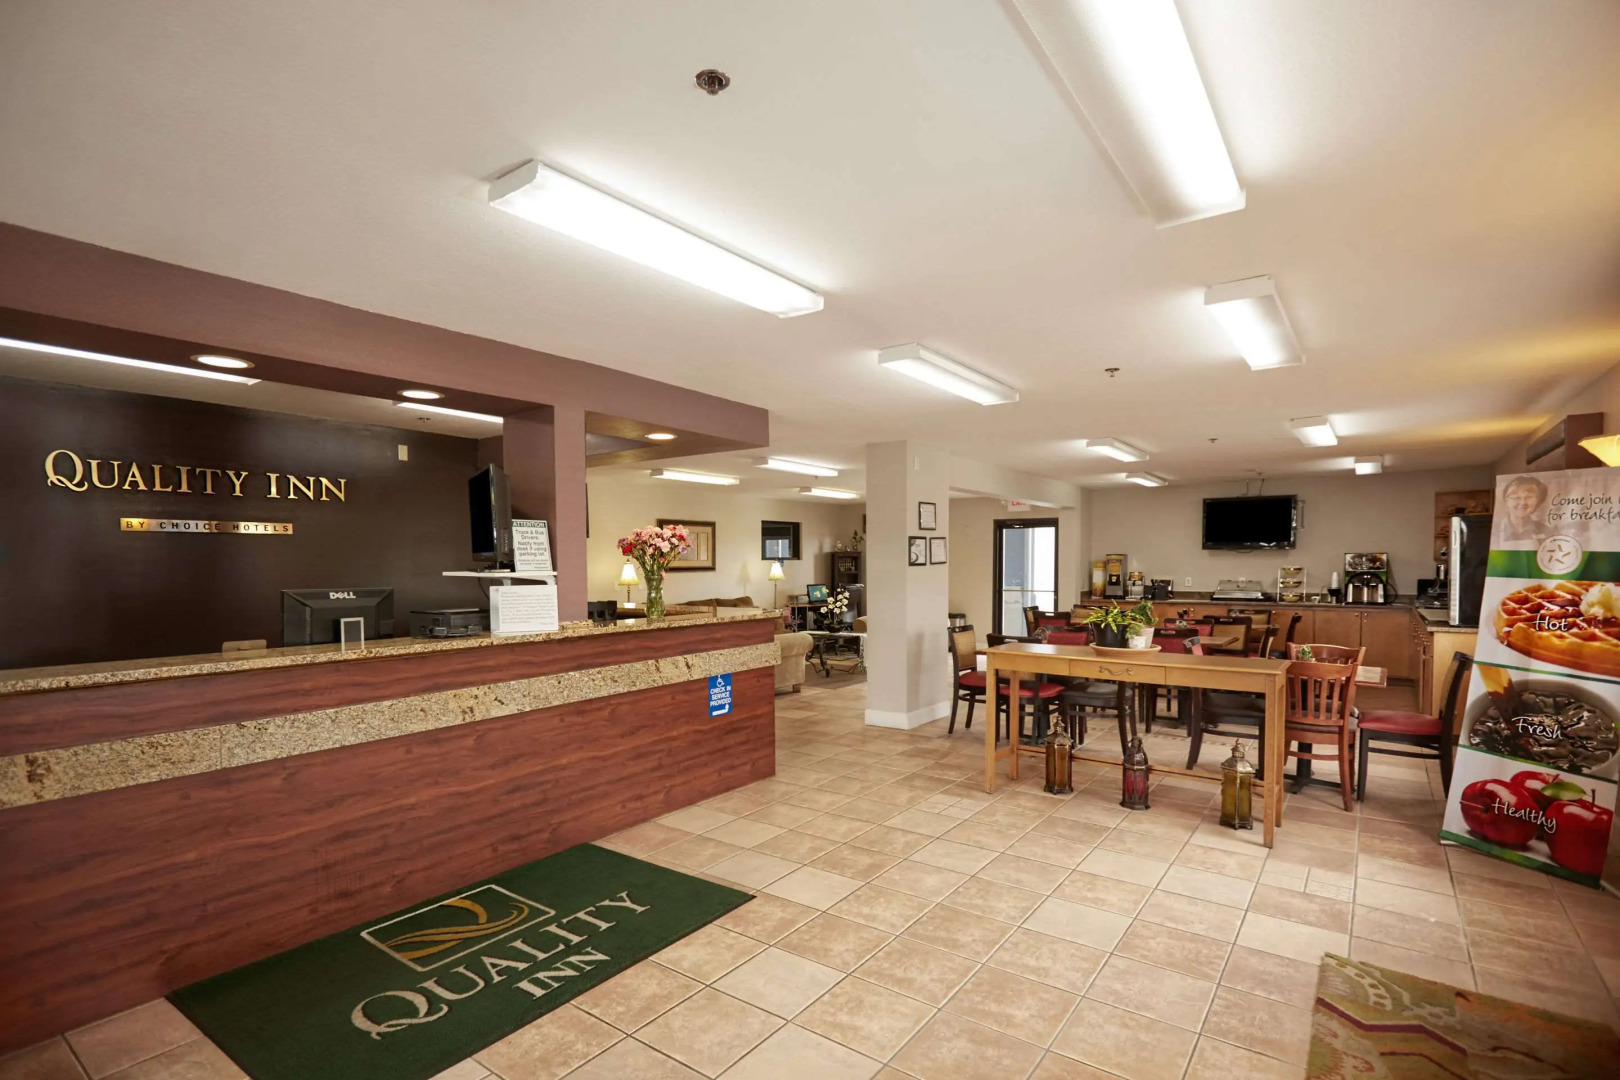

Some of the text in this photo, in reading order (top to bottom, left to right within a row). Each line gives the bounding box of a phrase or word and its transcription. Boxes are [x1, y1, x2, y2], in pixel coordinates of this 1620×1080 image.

[44, 449, 347, 502] QUALITY INN
[1551, 493, 1585, 506] Come
[1586, 493, 1613, 511] join
[1547, 508, 1566, 525] for
[126, 521, 289, 532] BY CHOICE HOTELS
[329, 591, 356, 600] DELL
[1533, 613, 1569, 632] Hot
[710, 698, 731, 706] PROVIDED
[712, 692, 730, 700] SERVICE
[1511, 716, 1564, 740] Fresh
[1491, 797, 1558, 834] Healthy
[350, 890, 651, 1040] QUALITY
[512, 946, 612, 1001] INN
